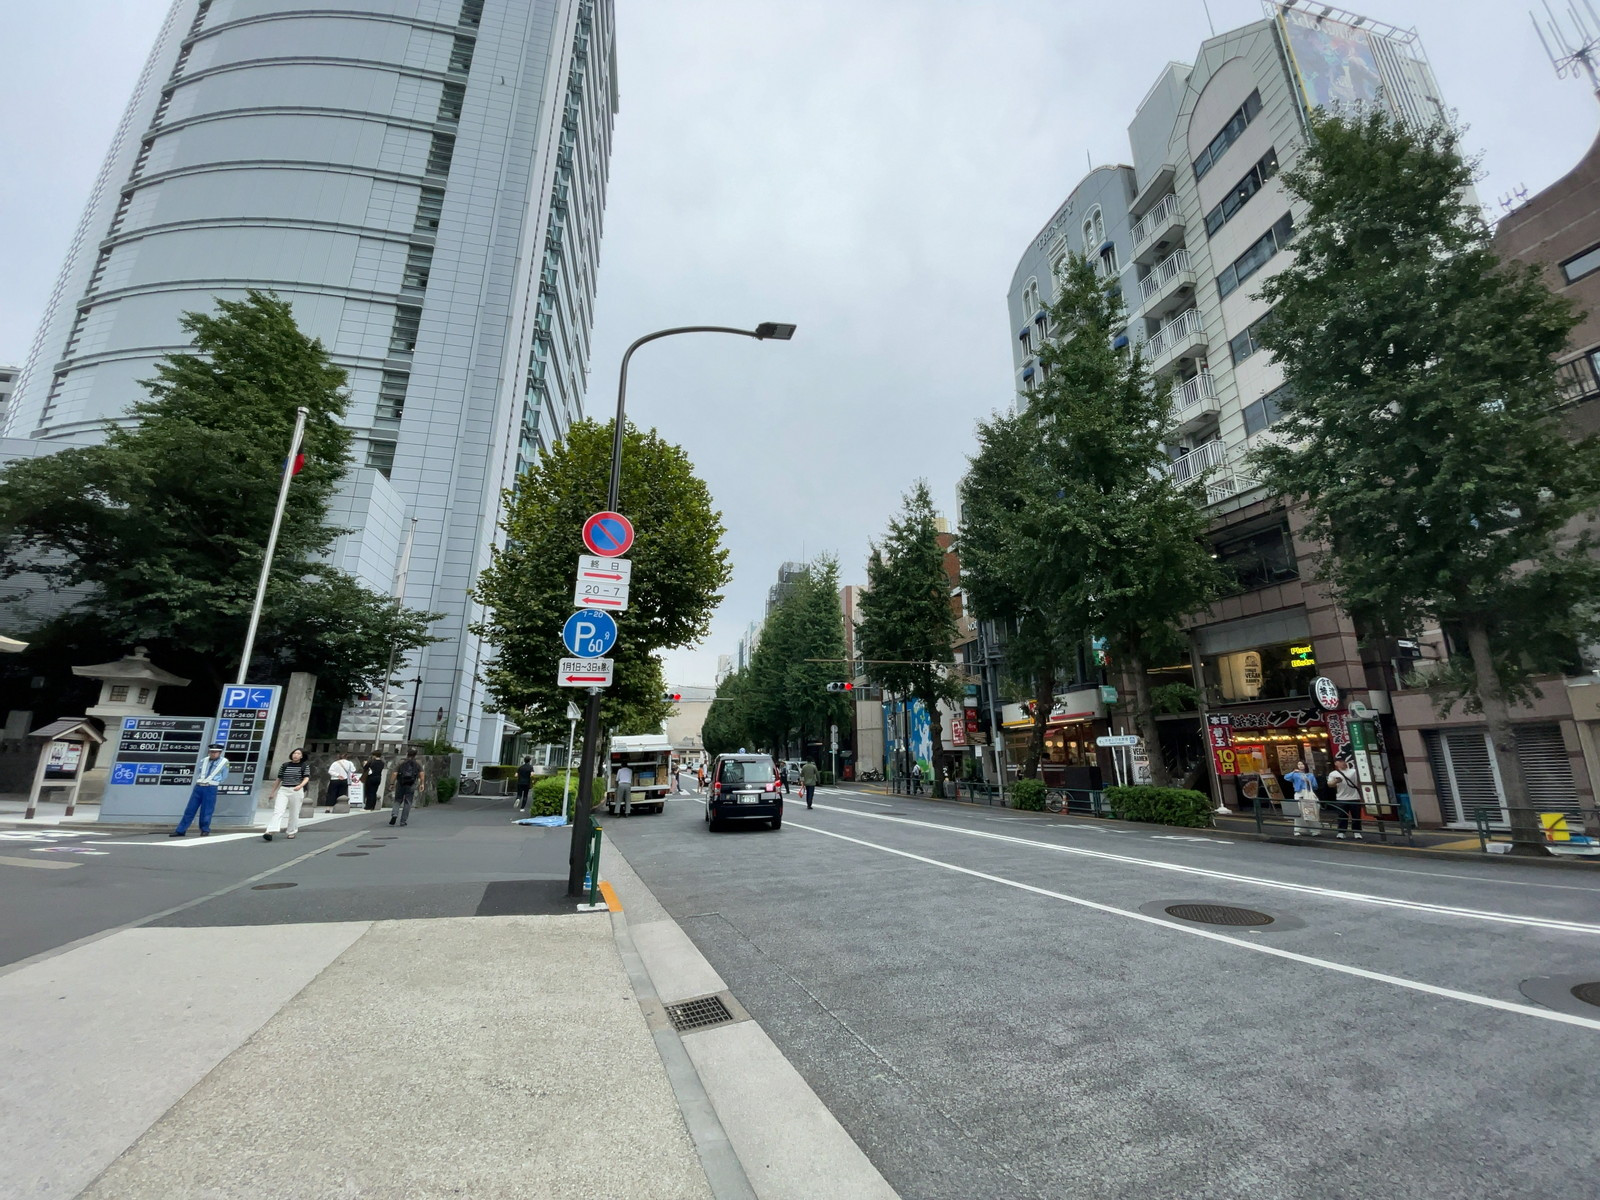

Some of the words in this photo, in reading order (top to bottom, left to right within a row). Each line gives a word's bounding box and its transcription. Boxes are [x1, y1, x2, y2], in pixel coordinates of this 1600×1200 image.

[574, 622, 596, 652] P
[228, 689, 246, 707] P
[126, 720, 135, 729] P
[1210, 716, 1229, 725] 本日
